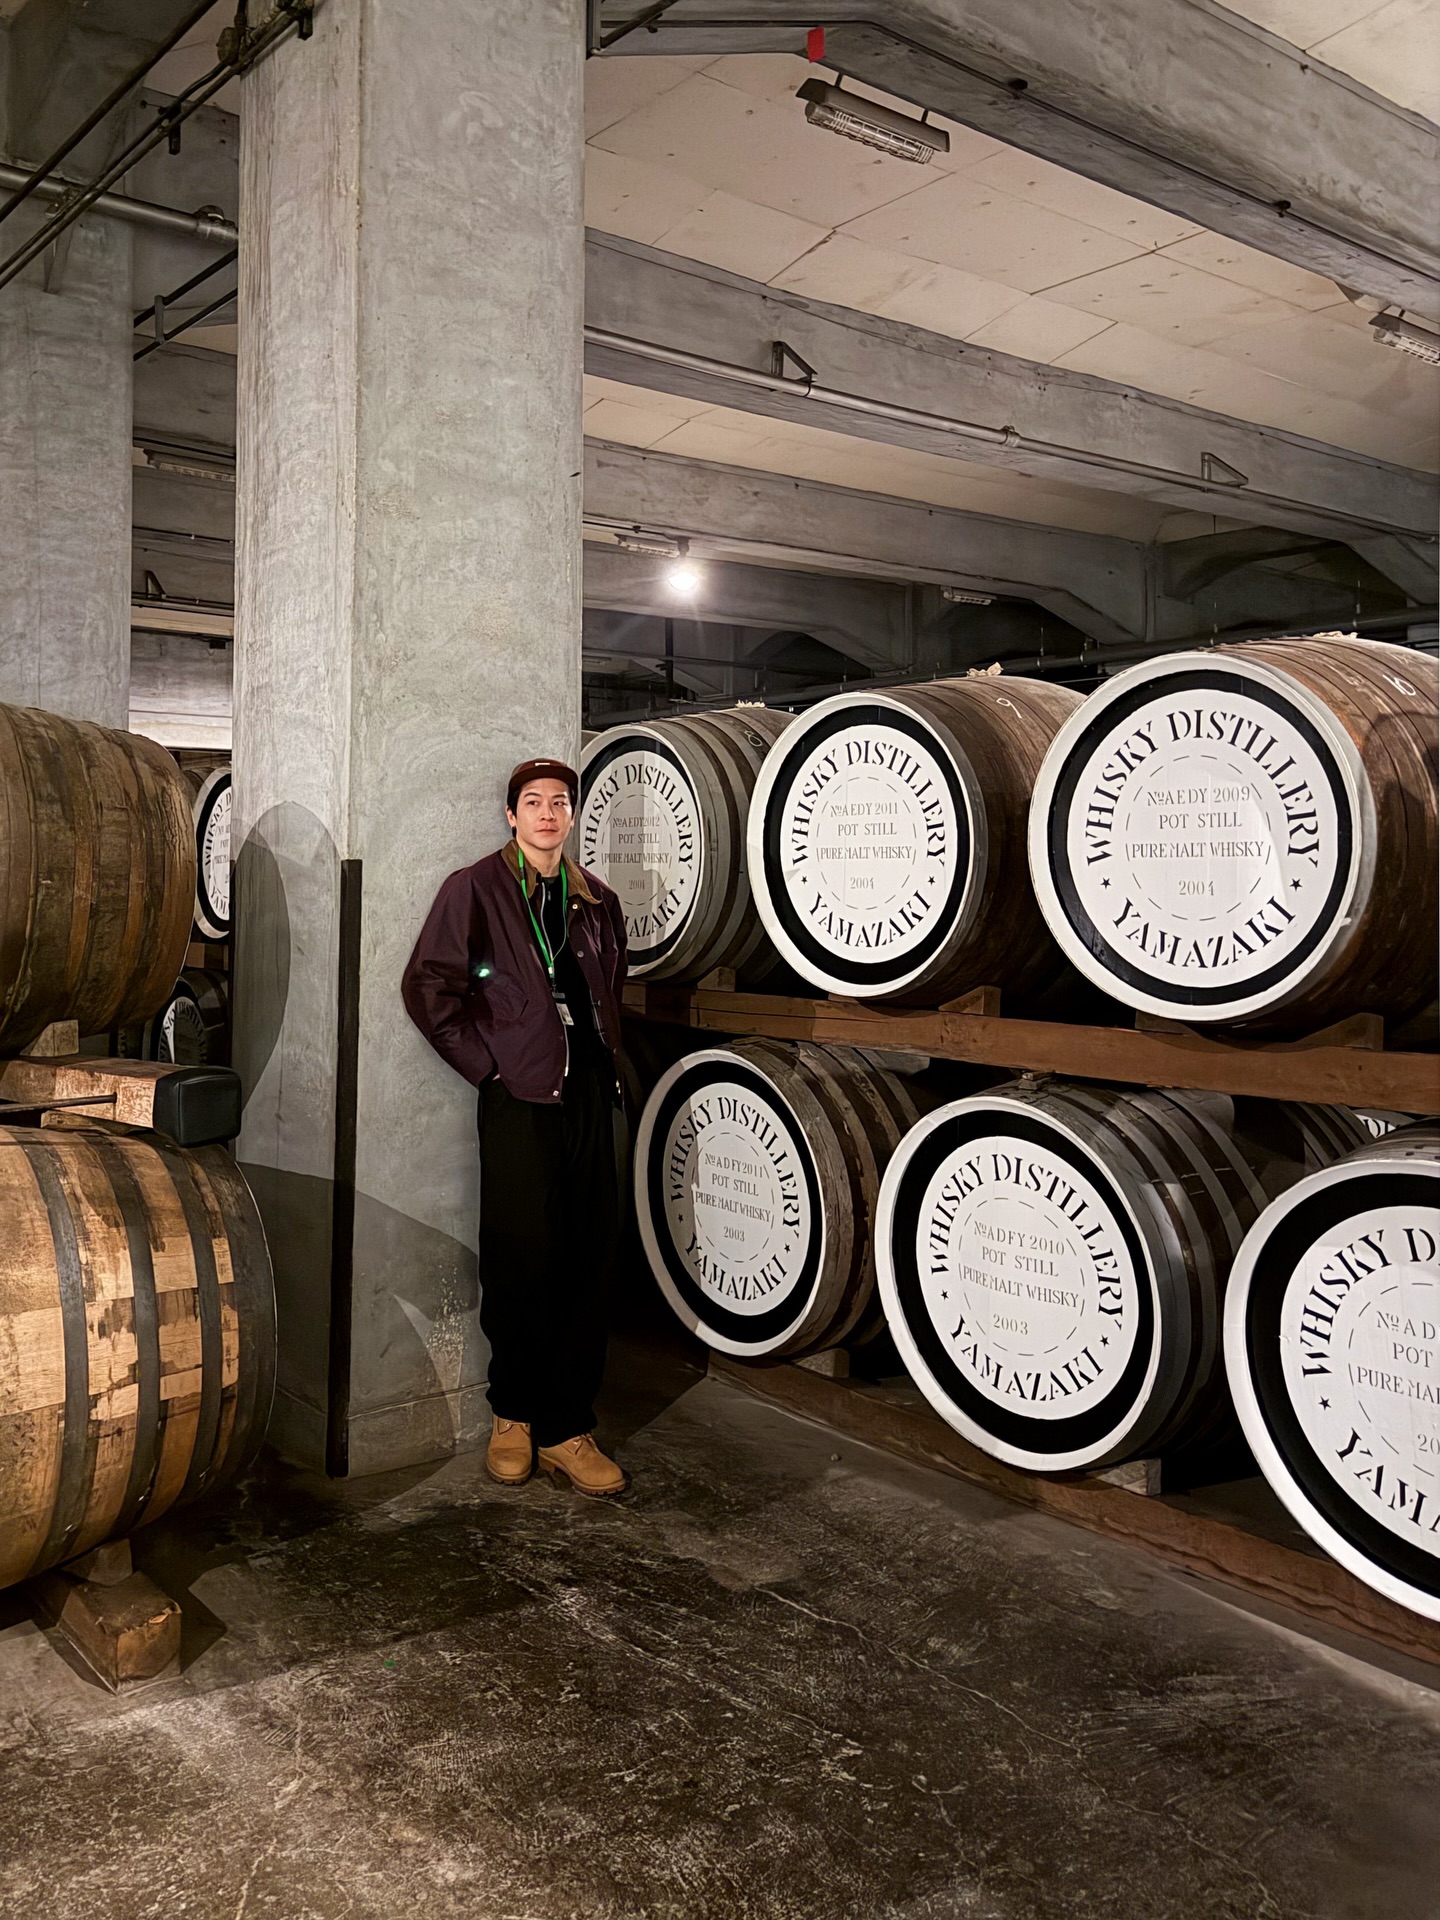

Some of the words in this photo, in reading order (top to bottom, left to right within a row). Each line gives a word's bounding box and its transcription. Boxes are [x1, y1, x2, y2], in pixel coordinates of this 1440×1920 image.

[792, 749, 840, 866] WHISKY
[844, 740, 946, 867] DISTILLERY
[1086, 721, 1159, 866] WHISKY
[1167, 709, 1319, 868] DISTILLERY
[1213, 786, 1250, 803] 2009
[584, 774, 621, 868] WHISKY
[625, 763, 694, 870] DISTILLERY
[874, 802, 898, 815] 2011
[1159, 813, 1189, 829] POT
[1197, 812, 1242, 828] STILL
[618, 833, 635, 844] POT
[637, 833, 660, 844] STILL
[838, 823, 859, 836] POT
[864, 822, 897, 835] STILL
[820, 847, 843, 859] PURE
[872, 846, 912, 859] WHISKY
[1132, 843, 1168, 858] PURE
[1210, 841, 1264, 857] WHISKY
[624, 888, 682, 938] AZAKI
[809, 890, 931, 948] YAMAZAKI
[1112, 896, 1297, 969] YAMAZAKI
[670, 1099, 714, 1203] WHISKY
[717, 1096, 800, 1239] DISTILLERY
[712, 1172, 729, 1188] POT
[733, 1178, 759, 1197] STILL
[695, 1191, 717, 1207] PURE
[740, 1203, 771, 1223] WHISKY
[723, 1225, 745, 1242] 2003
[930, 1155, 984, 1276] WHISKY
[991, 1153, 1124, 1330] DISTILLERY
[1029, 1235, 1065, 1256] 2010
[685, 1233, 787, 1301] YAMAZAKI
[982, 1245, 1006, 1266] POT
[1014, 1255, 1059, 1277] STILL
[963, 1265, 989, 1288] PURE
[1026, 1284, 1079, 1308] WHISKY
[1300, 1229, 1392, 1378] WHISKY
[993, 1313, 1029, 1335] 2003
[950, 1314, 1104, 1401] YAMAZAKI
[1393, 1342, 1433, 1368] POT
[1357, 1365, 1404, 1395] PURE
